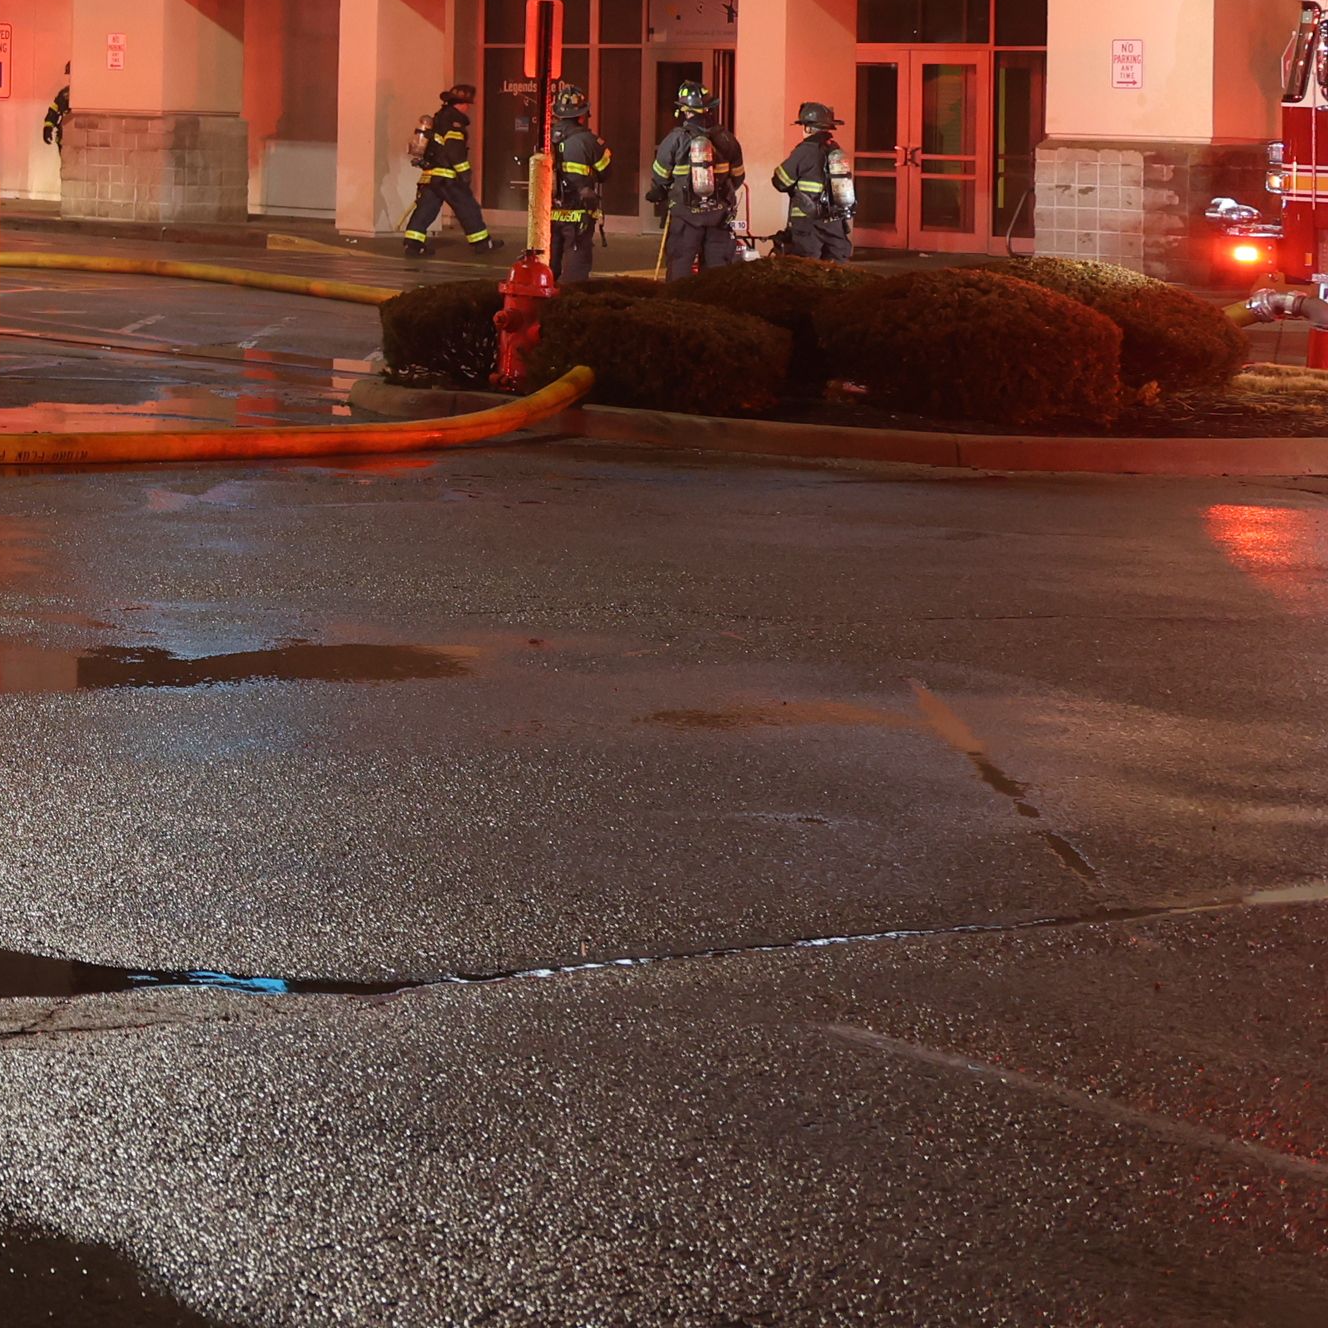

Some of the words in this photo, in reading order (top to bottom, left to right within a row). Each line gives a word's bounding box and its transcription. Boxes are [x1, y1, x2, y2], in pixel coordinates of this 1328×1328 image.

[1121, 43, 1134, 53] NO
[1113, 54, 1142, 64] PARKING
[503, 80, 538, 96] Legends
